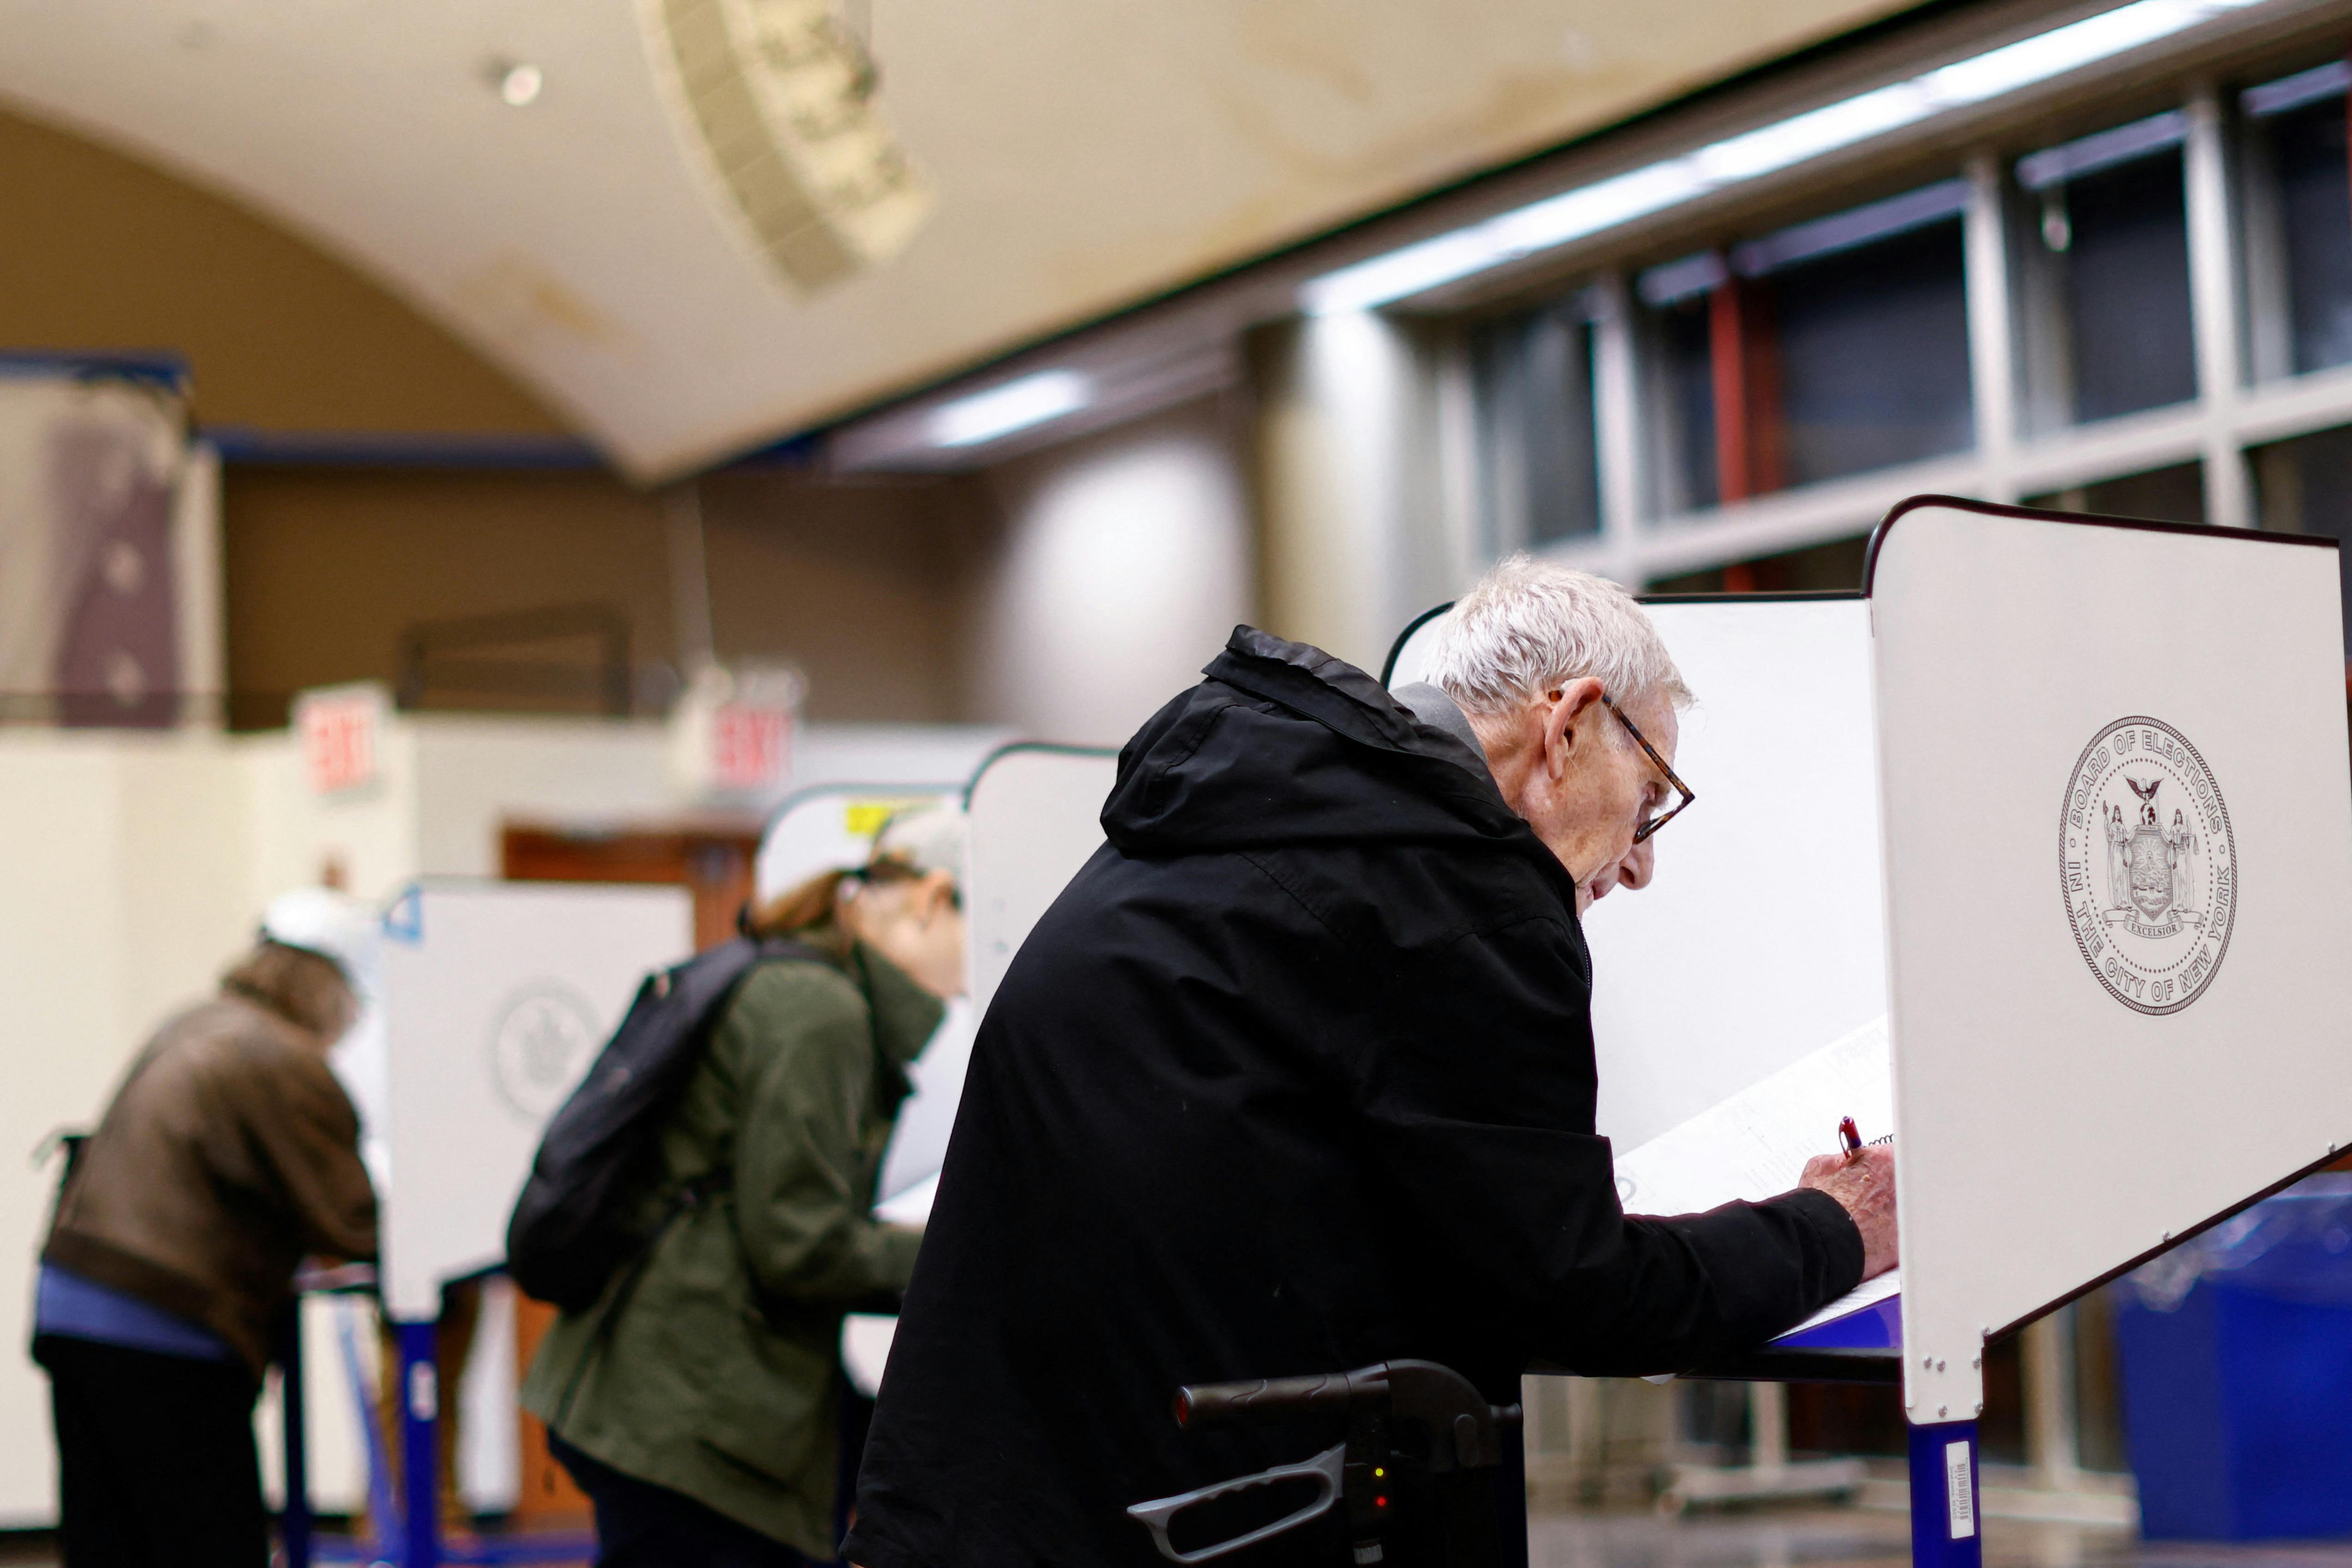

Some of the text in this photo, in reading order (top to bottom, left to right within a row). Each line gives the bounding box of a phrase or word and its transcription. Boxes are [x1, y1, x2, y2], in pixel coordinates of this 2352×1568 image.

[2070, 730, 2222, 834] BOARD OF ELECTIONS
[2068, 862, 2230, 1002] IN THE CITY OF NEW YORK
[2131, 924, 2178, 937] EXCELSIOR
